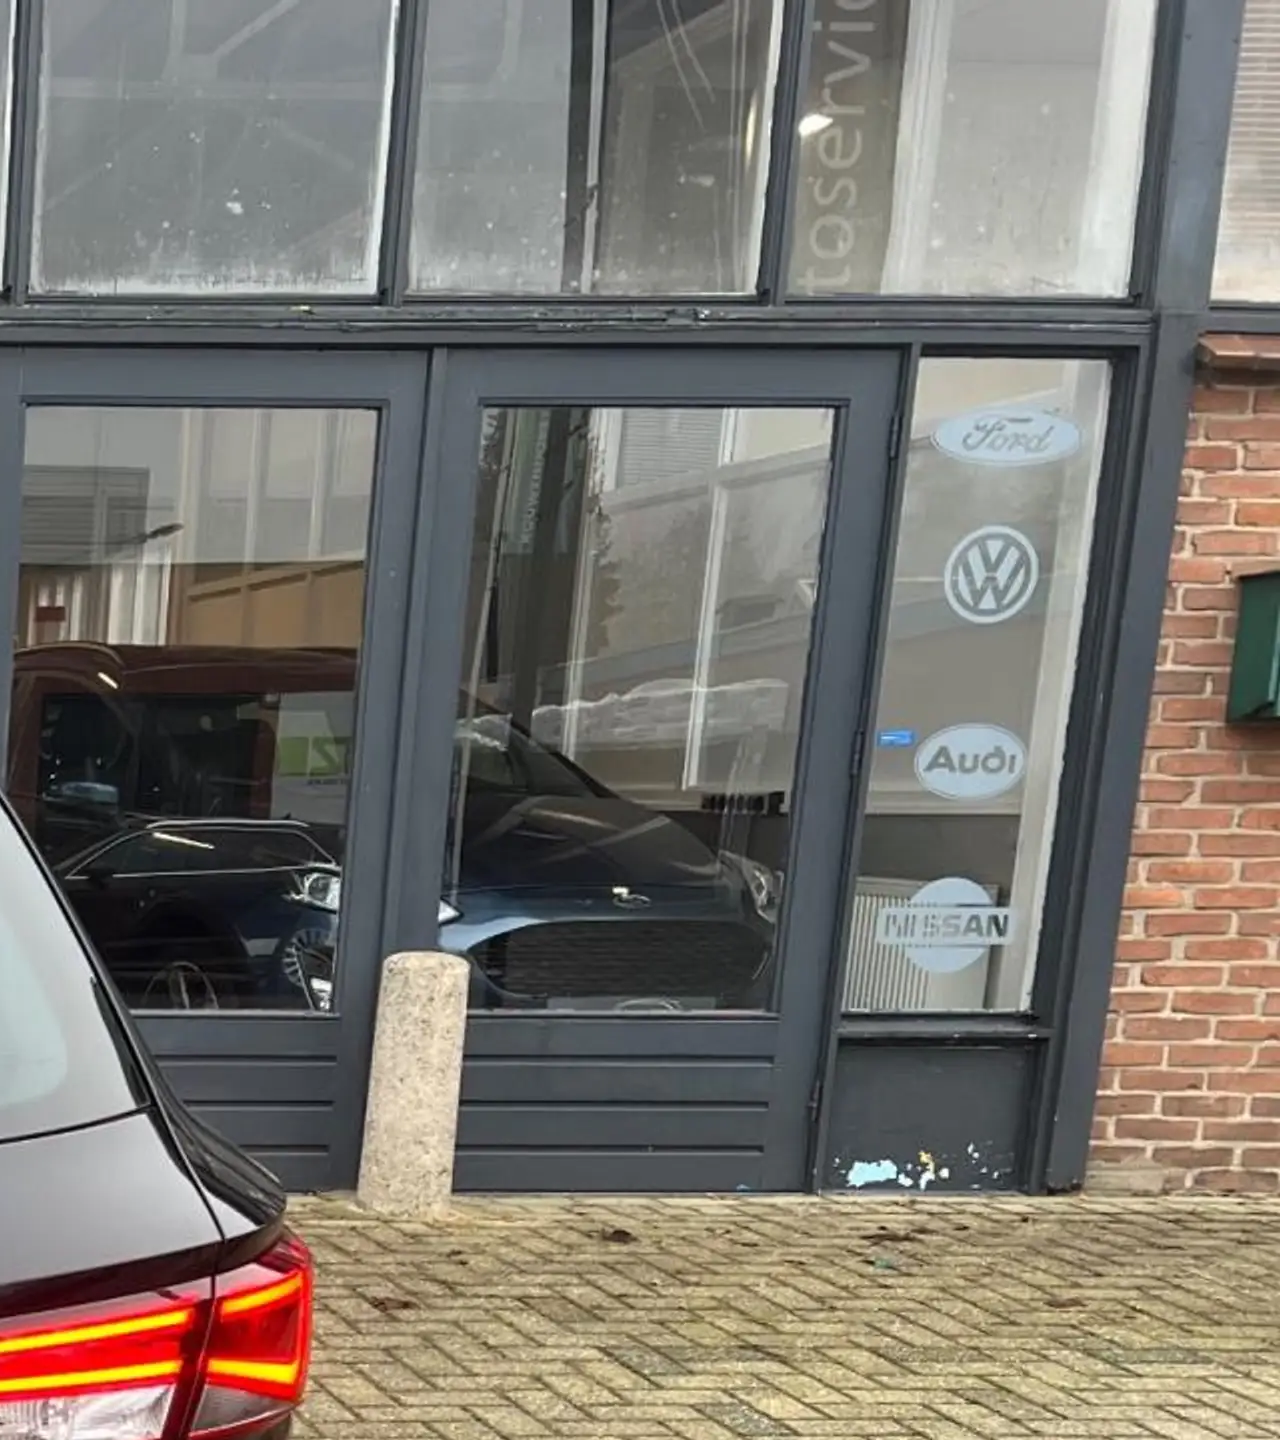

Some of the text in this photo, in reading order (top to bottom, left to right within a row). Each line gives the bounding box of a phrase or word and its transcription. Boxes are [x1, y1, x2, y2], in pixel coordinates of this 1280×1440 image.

[962, 416, 1055, 453] Ford
[923, 744, 1018, 775] Audi
[883, 913, 1010, 939] NISSAN
